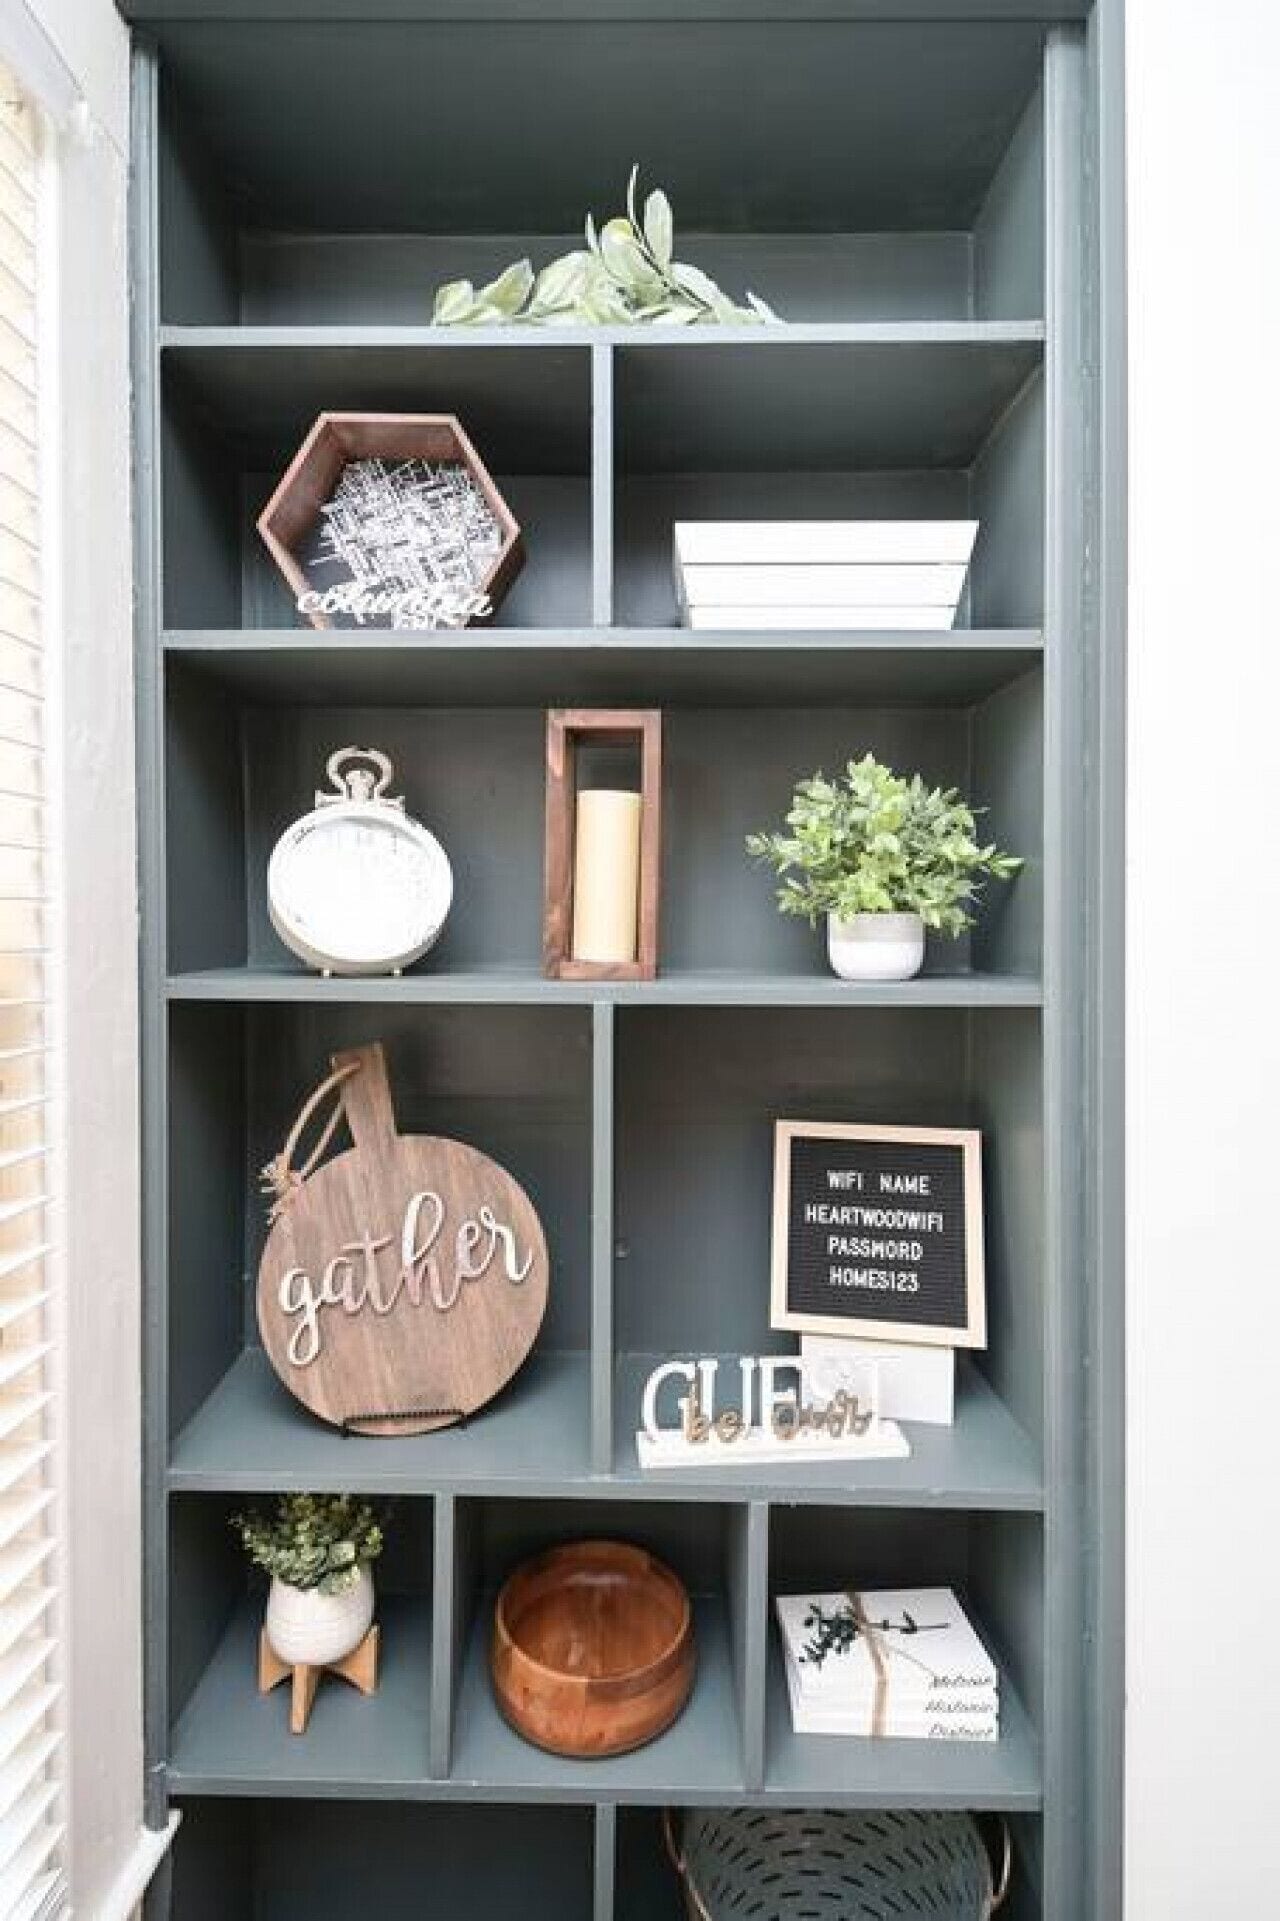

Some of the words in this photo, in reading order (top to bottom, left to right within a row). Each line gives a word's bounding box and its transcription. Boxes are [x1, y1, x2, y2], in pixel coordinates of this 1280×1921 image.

[827, 1170, 863, 1191] WIFI
[879, 1174, 932, 1196] NAME
[804, 1203, 944, 1232] HEARTWOODWIFI
[828, 1235, 924, 1261] PASSWORD
[279, 1191, 533, 1366] gather
[828, 1266, 920, 1292] HOMES123
